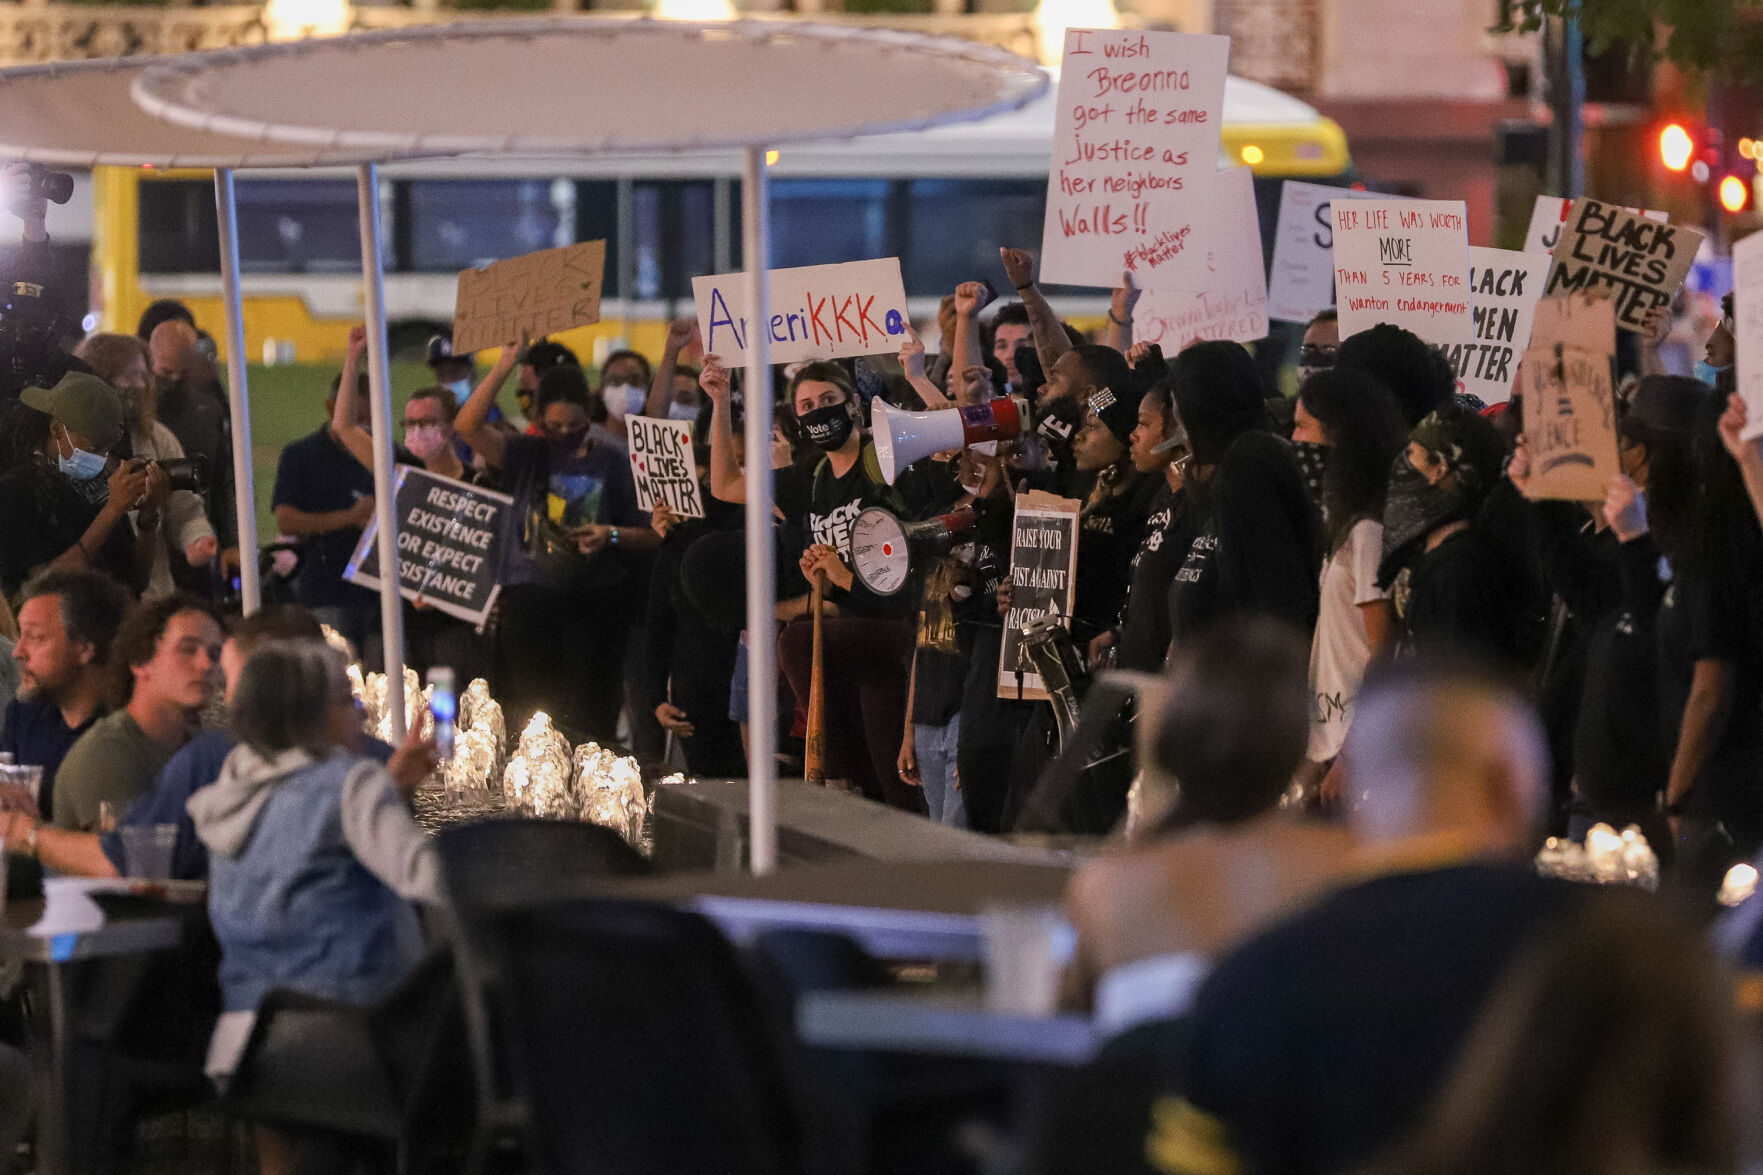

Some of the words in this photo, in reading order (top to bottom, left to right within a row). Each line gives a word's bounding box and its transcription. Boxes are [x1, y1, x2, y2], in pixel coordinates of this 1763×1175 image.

[1068, 30, 1094, 54] I
[1104, 35, 1150, 58] wish
[1088, 67, 1190, 98] Breonna
[1073, 104, 1115, 130] got
[1126, 98, 1157, 124] the
[1164, 107, 1208, 125] same
[1163, 149, 1188, 166] as
[1060, 170, 1095, 197] her
[1103, 171, 1183, 199] neighbors
[1338, 210, 1359, 231] HER
[1365, 210, 1389, 230] LIFE
[1400, 211, 1424, 229] WAS
[1429, 212, 1462, 231] WORTH
[1575, 200, 1677, 260] BLACK
[1379, 237, 1412, 262] MORE
[1571, 234, 1668, 285] LIVES
[1337, 268, 1368, 285] THAN
[1383, 271, 1390, 286] 5
[1400, 272, 1435, 287] YEARS
[1442, 274, 1461, 287] FOR
[1470, 267, 1528, 296] LACK
[1474, 306, 1518, 343] MEN
[632, 420, 684, 459] BLACK
[806, 424, 830, 434] Vote
[646, 455, 688, 478] LIVES
[426, 487, 498, 523] RESPECT
[637, 475, 701, 515] MATTER
[407, 508, 493, 549] EXISTENCE
[1016, 527, 1038, 548] RAISE
[1039, 528, 1062, 550] YOUR
[397, 532, 422, 554] OR
[421, 540, 484, 574] EXPECT
[399, 558, 477, 600] SISTANCE
[1029, 568, 1066, 590] AGAINST
